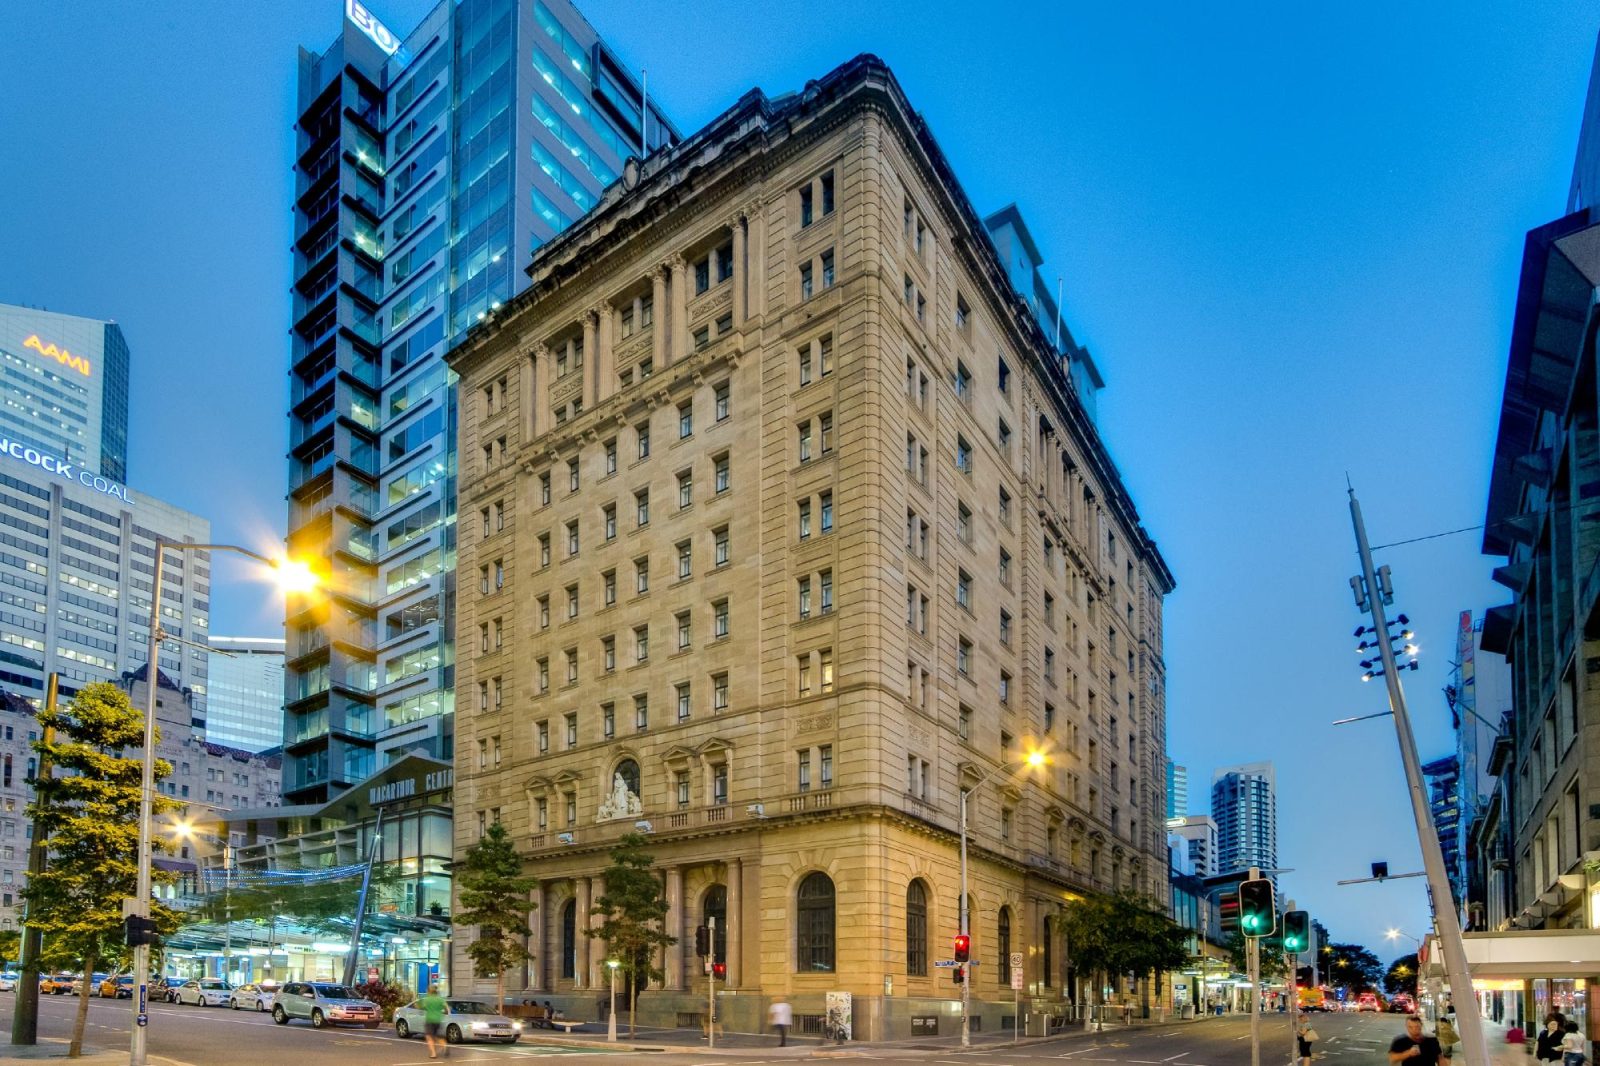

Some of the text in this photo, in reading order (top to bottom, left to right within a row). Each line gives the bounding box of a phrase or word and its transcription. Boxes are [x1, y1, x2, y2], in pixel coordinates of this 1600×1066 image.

[23, 334, 91, 376] AAMI
[79, 471, 136, 505] COAL
[369, 778, 416, 805] MACARTHUR
